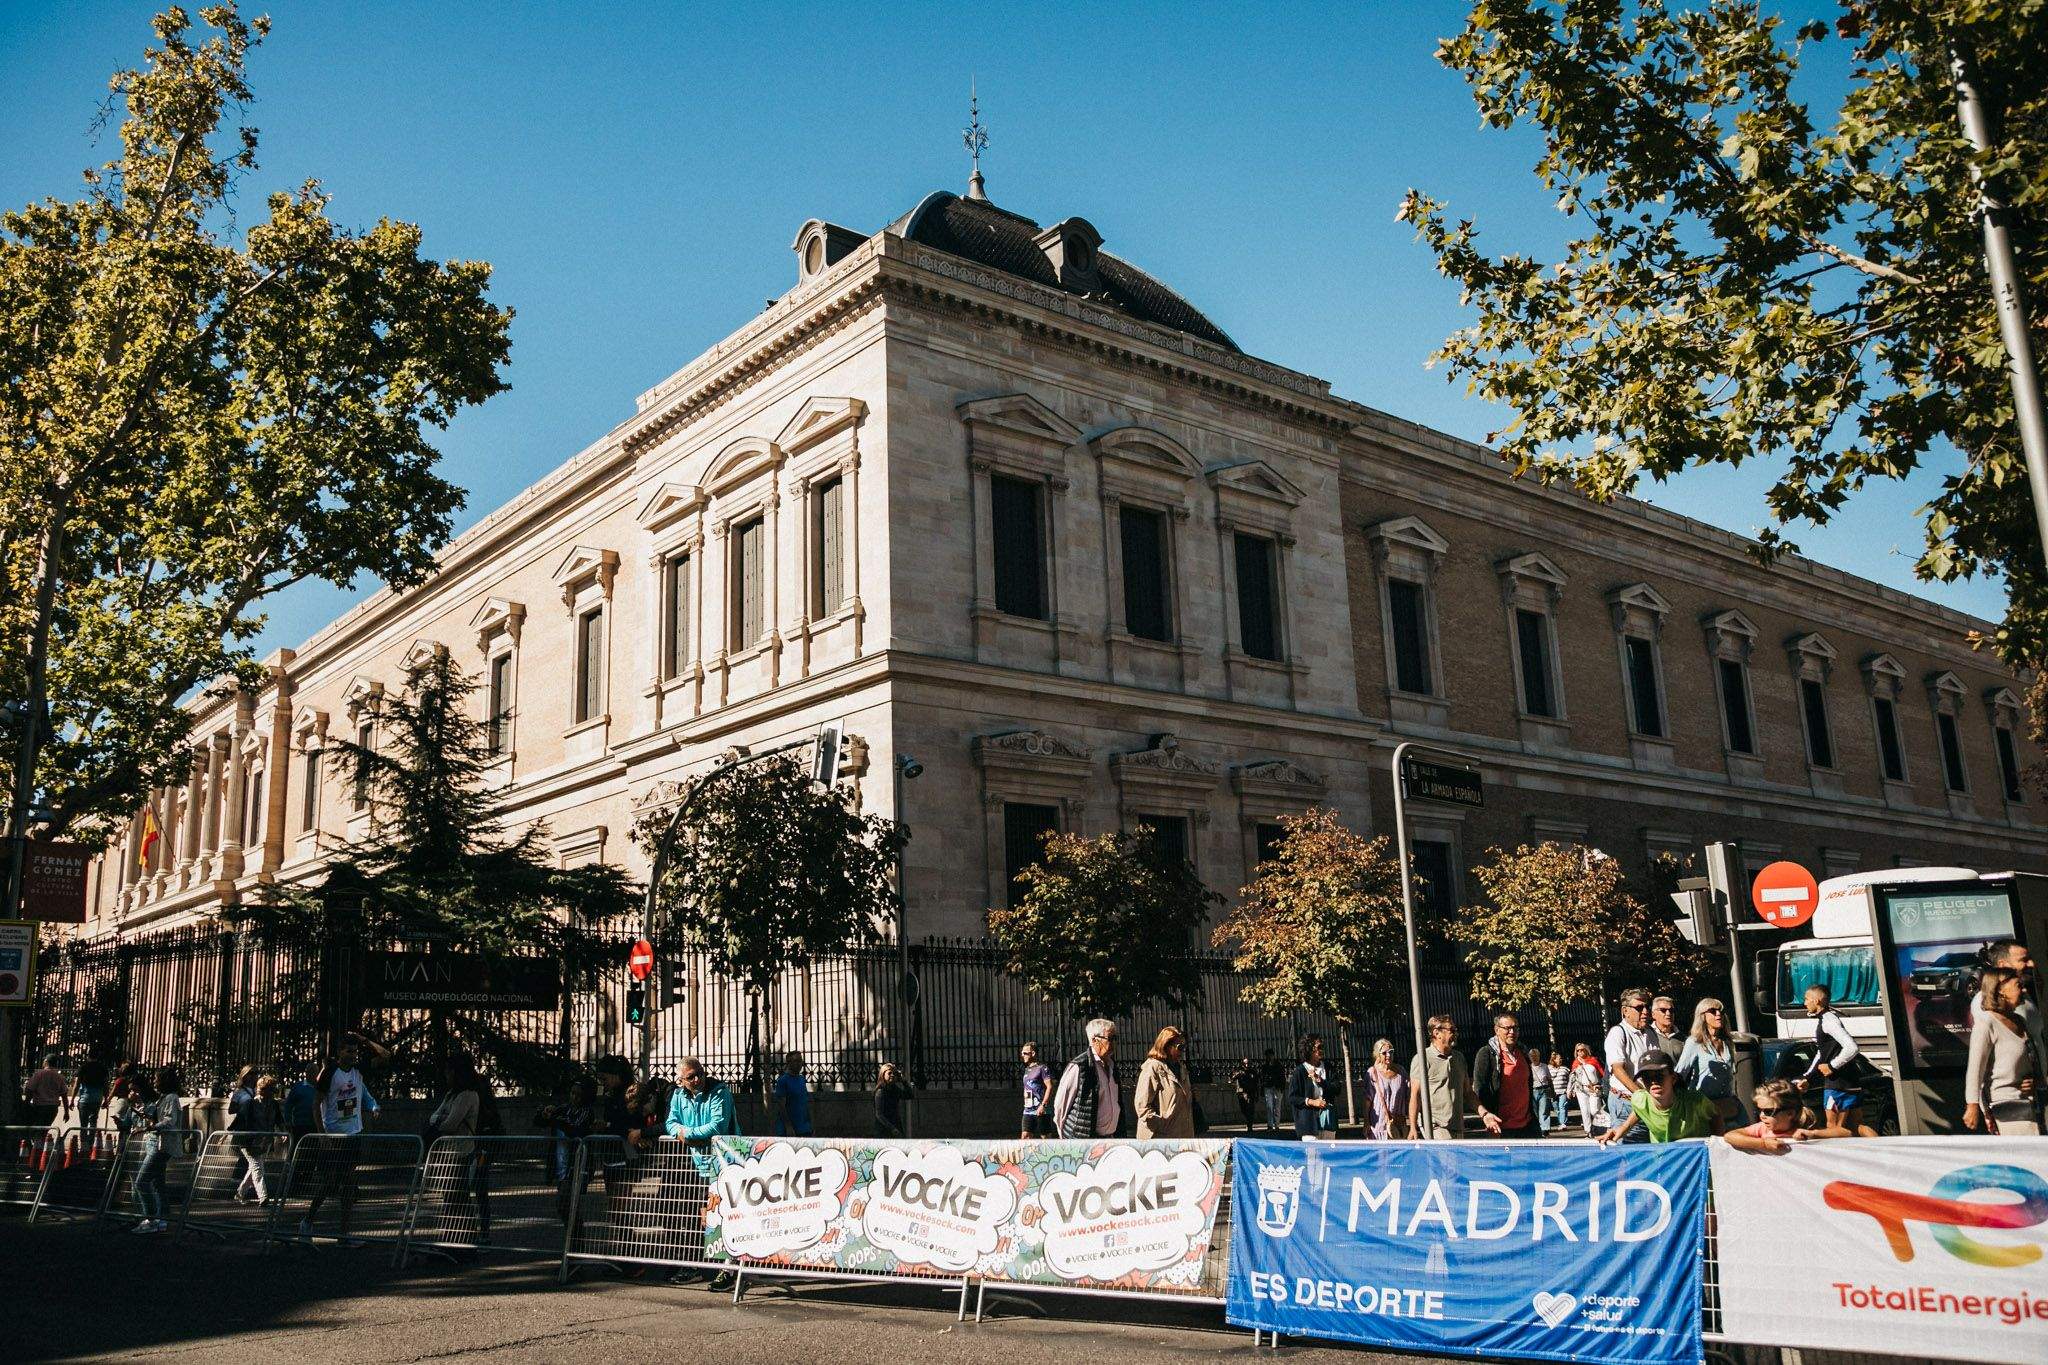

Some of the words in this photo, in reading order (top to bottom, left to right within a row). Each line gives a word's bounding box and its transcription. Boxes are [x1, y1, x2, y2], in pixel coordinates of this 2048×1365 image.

[1422, 781, 1431, 796] LA
[1432, 782, 1453, 799] ARMADA
[1455, 786, 1483, 804] ESPAÑOLA
[1923, 899, 1996, 910] PEUGEOT
[384, 992, 416, 1001] MUSEO
[490, 993, 534, 1003] NACIONAL
[725, 1167, 823, 1209] VOCKE
[883, 1165, 988, 1222] VOCKE
[1053, 1172, 1180, 1224] VOCKE
[879, 1202, 977, 1236] www.vockesock.com
[1347, 1177, 1672, 1243] MADRID
[789, 1226, 811, 1235] VOCKE
[1057, 1213, 1180, 1238] www.vockesock.com
[879, 1228, 901, 1241] VOCKE
[907, 1236, 929, 1249] VOCKE
[935, 1244, 958, 1258] VOCKE
[1071, 1252, 1099, 1264] VOCKE
[1107, 1247, 1134, 1258] VOCKE
[1142, 1241, 1169, 1252] VOCKE
[1250, 1271, 1288, 1301] ES
[1295, 1277, 1444, 1320] DEPORTE
[1581, 1309, 1623, 1321] +salud
